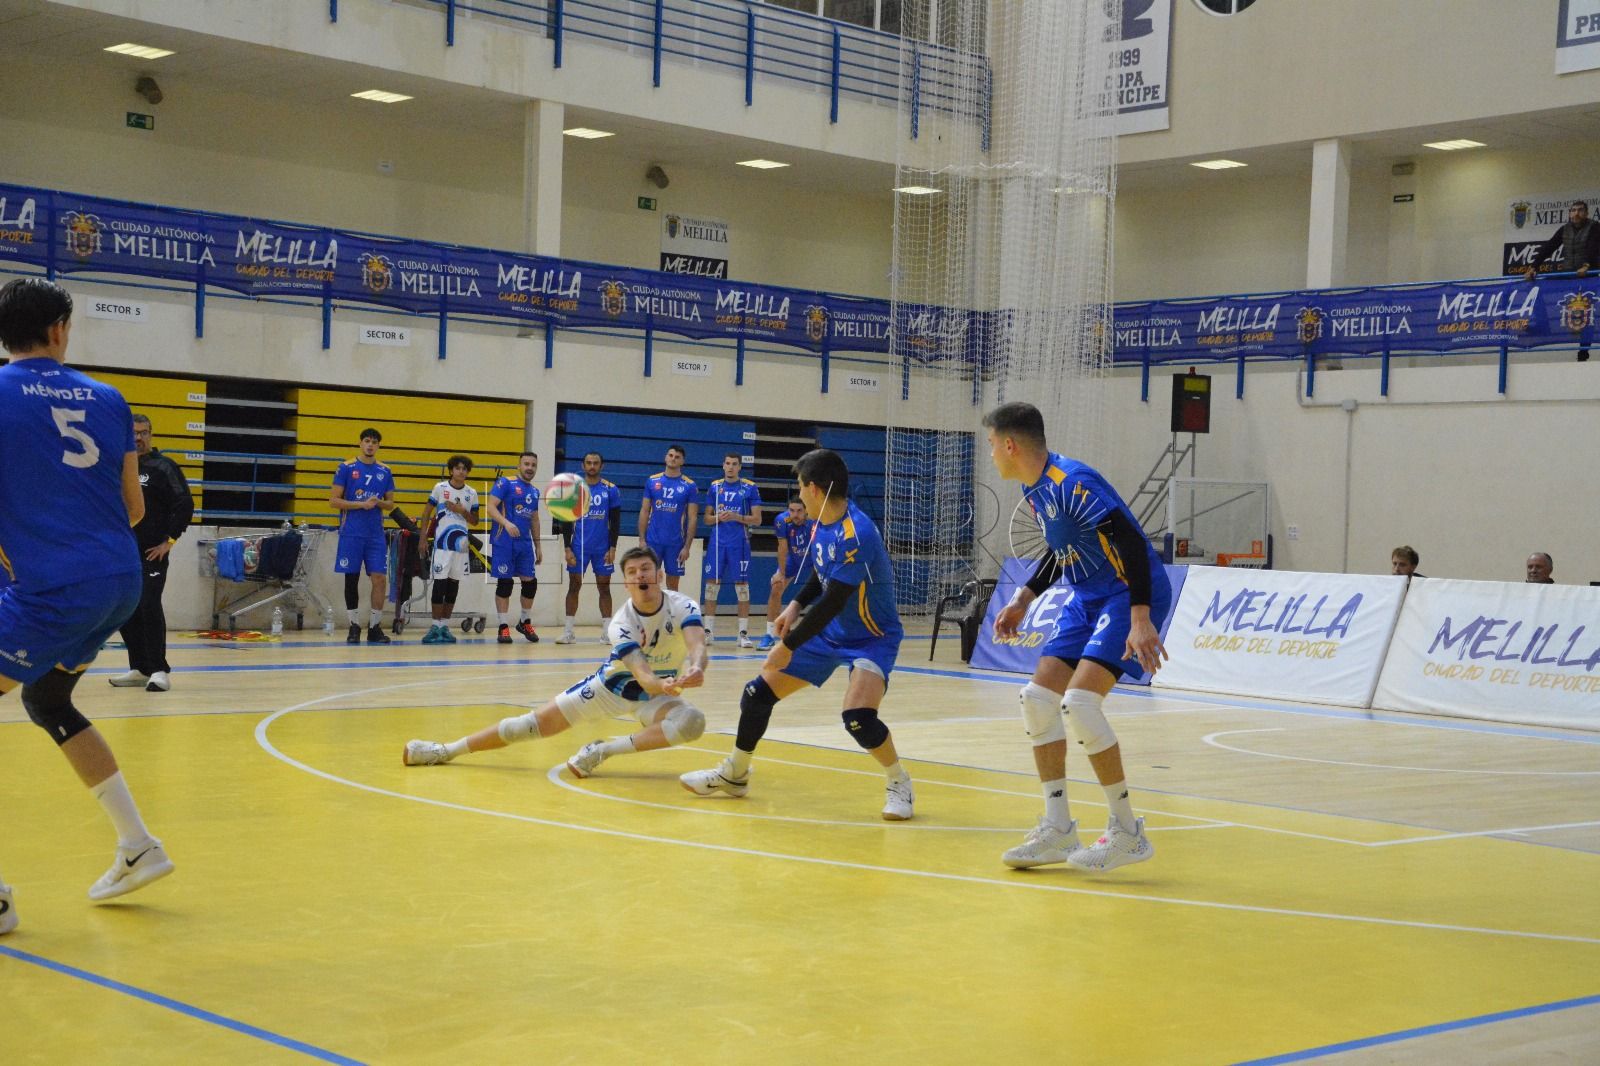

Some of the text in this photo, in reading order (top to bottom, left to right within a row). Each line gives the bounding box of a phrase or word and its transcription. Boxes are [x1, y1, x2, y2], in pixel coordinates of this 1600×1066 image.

[111, 221, 215, 244] CIUDAD AUTÓNOMA
[683, 226, 728, 243] MELILLA
[113, 233, 217, 267] MELILLA
[235, 229, 338, 269] MELILLA
[273, 267, 292, 278] DEL
[398, 260, 480, 277] CIUDAD AUTÓNOMA
[664, 256, 725, 279] MELILLA
[400, 271, 482, 298] MELILLA
[497, 263, 582, 299] MELILLA
[632, 285, 701, 301] CIUDAD AUTÓNOMA
[95, 303, 141, 316] SECTOR 5
[634, 295, 702, 323] MELILLA
[715, 289, 790, 320] MELILLA
[1331, 303, 1412, 317] CIUDAD AUTÓNOMA
[1437, 286, 1540, 321] MELILLA
[833, 311, 856, 320] CIUDAD
[1114, 320, 1139, 329] CIUDAD
[1196, 303, 1281, 334] MELILLA
[367, 330, 396, 340] SECTOR
[834, 320, 892, 340] MELILLA
[1332, 316, 1412, 337] MELILLA
[1437, 321, 1470, 333] CIUDAD
[1473, 320, 1489, 330] DEL
[1115, 328, 1182, 347] MELILLA
[677, 362, 707, 372] SECTOR 7
[21, 380, 97, 402] MÉNDEZ
[850, 377, 871, 386] SECTOR
[50, 405, 101, 469] 5
[364, 474, 372, 486] 7
[525, 493, 533, 504] 6
[662, 487, 675, 499] 12
[724, 491, 736, 502] 17
[816, 543, 824, 567] 3
[739, 560, 749, 572] 17
[1198, 588, 1364, 639] MELILLA
[1093, 613, 1111, 636] 9
[1193, 634, 1341, 659] CIUDAD DEL DEPORTE
[1423, 662, 1600, 693] CIUDAD DEL DEPORTE
